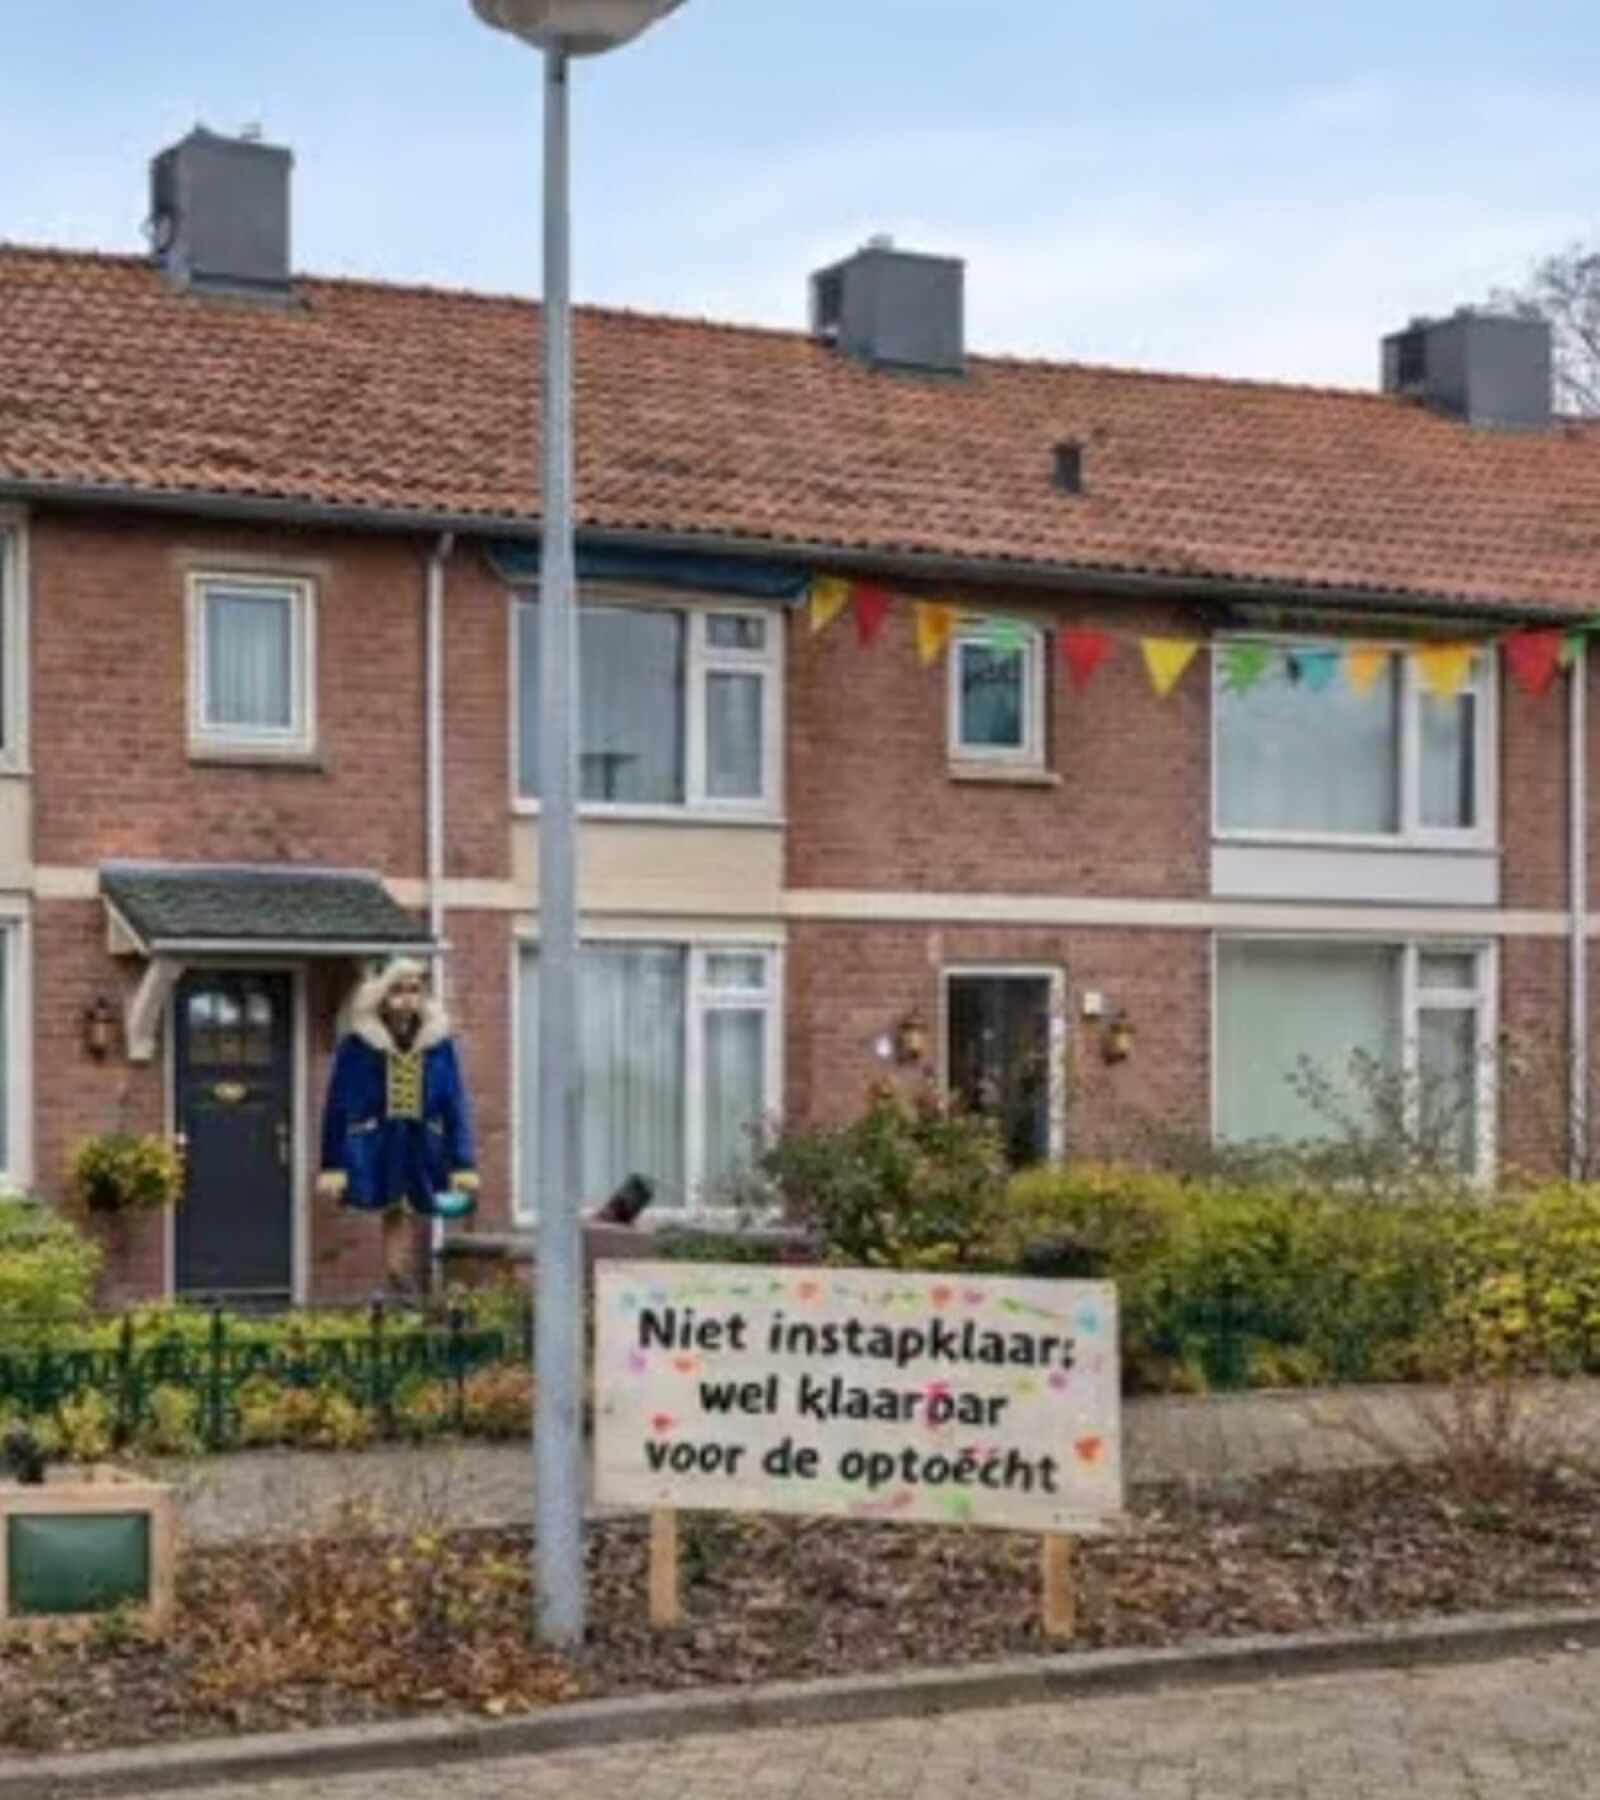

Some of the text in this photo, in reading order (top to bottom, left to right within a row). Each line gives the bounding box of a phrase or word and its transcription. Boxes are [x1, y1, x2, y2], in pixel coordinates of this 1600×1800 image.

[638, 1309, 748, 1351] Niet
[699, 1377, 778, 1416] wel
[645, 1439, 745, 1476] voor
[762, 1438, 819, 1479] de
